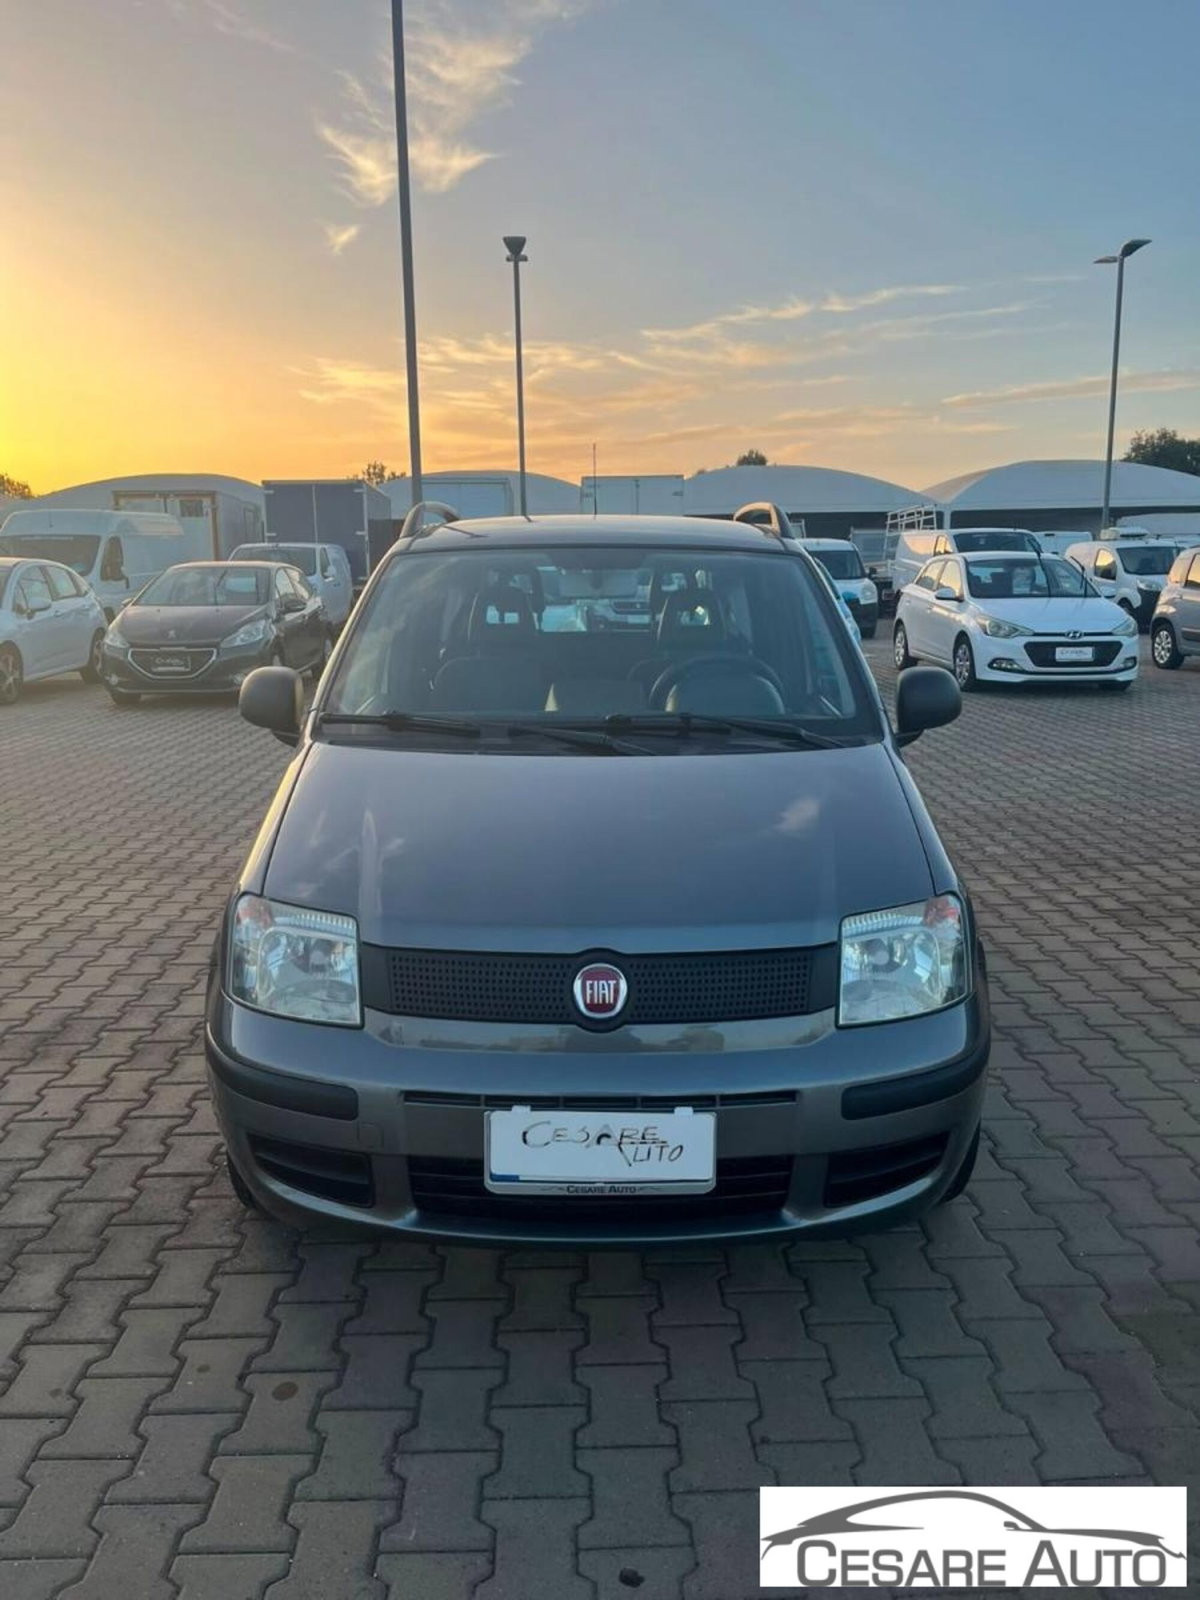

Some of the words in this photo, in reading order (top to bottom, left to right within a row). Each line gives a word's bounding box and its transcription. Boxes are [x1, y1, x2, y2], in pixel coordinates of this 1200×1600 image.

[586, 980, 616, 1004] FIAT
[566, 1184, 606, 1194] CESARE
[608, 1184, 637, 1194] AUTO
